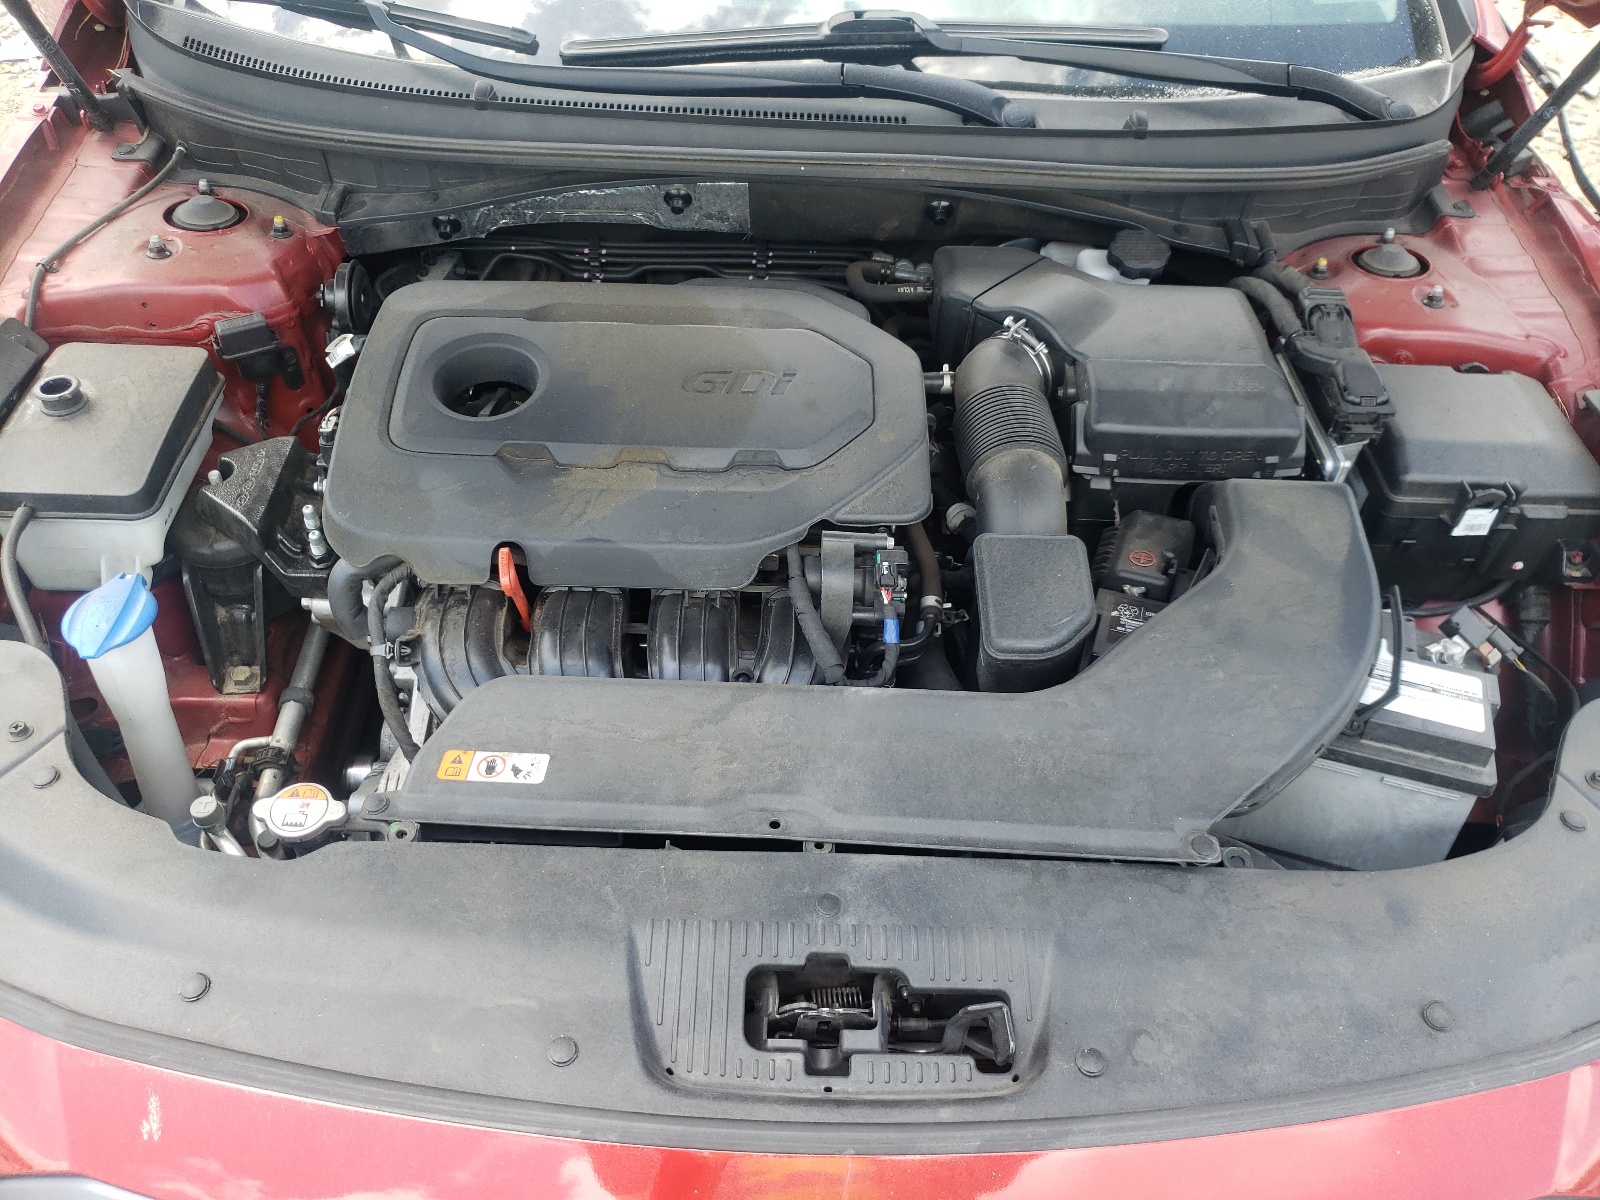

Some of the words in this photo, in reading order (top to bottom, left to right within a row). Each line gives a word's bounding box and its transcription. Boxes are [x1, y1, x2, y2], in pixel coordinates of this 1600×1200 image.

[680, 369, 798, 396] GDi
[1118, 449, 1158, 460] PULL
[1162, 450, 1195, 460] OUT
[1199, 451, 1218, 461] TO
[1222, 451, 1262, 461] OPEN
